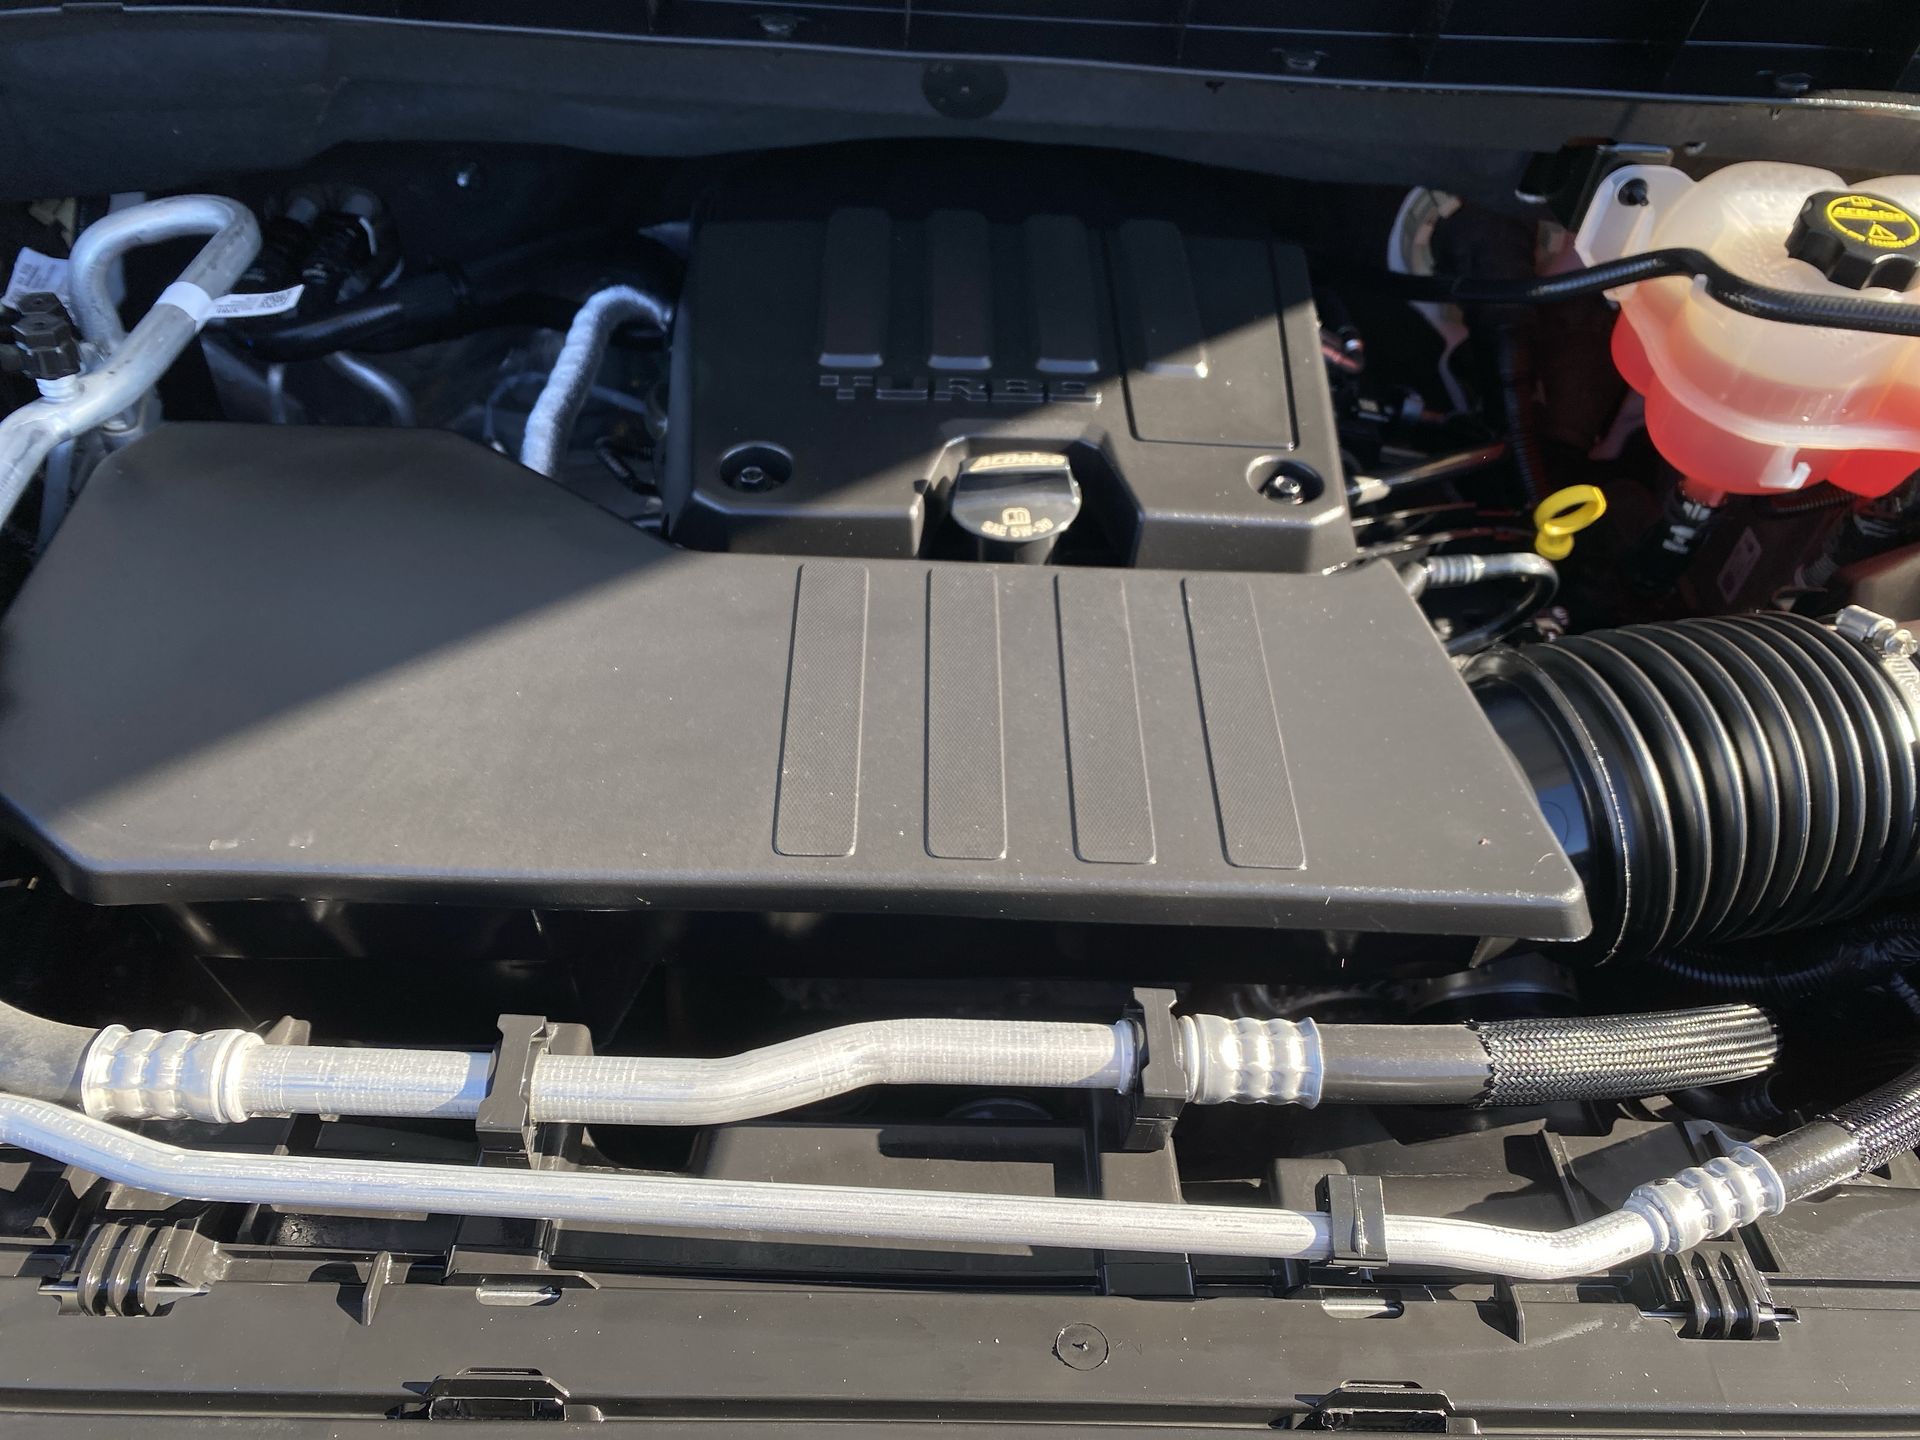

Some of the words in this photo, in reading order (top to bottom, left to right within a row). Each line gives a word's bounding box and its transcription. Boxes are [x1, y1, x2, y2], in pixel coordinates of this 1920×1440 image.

[819, 374, 1103, 403] TURBO
[969, 452, 1066, 472] ACDelco
[981, 520, 1008, 537] SAE
[1010, 517, 1054, 538] 5W-30
